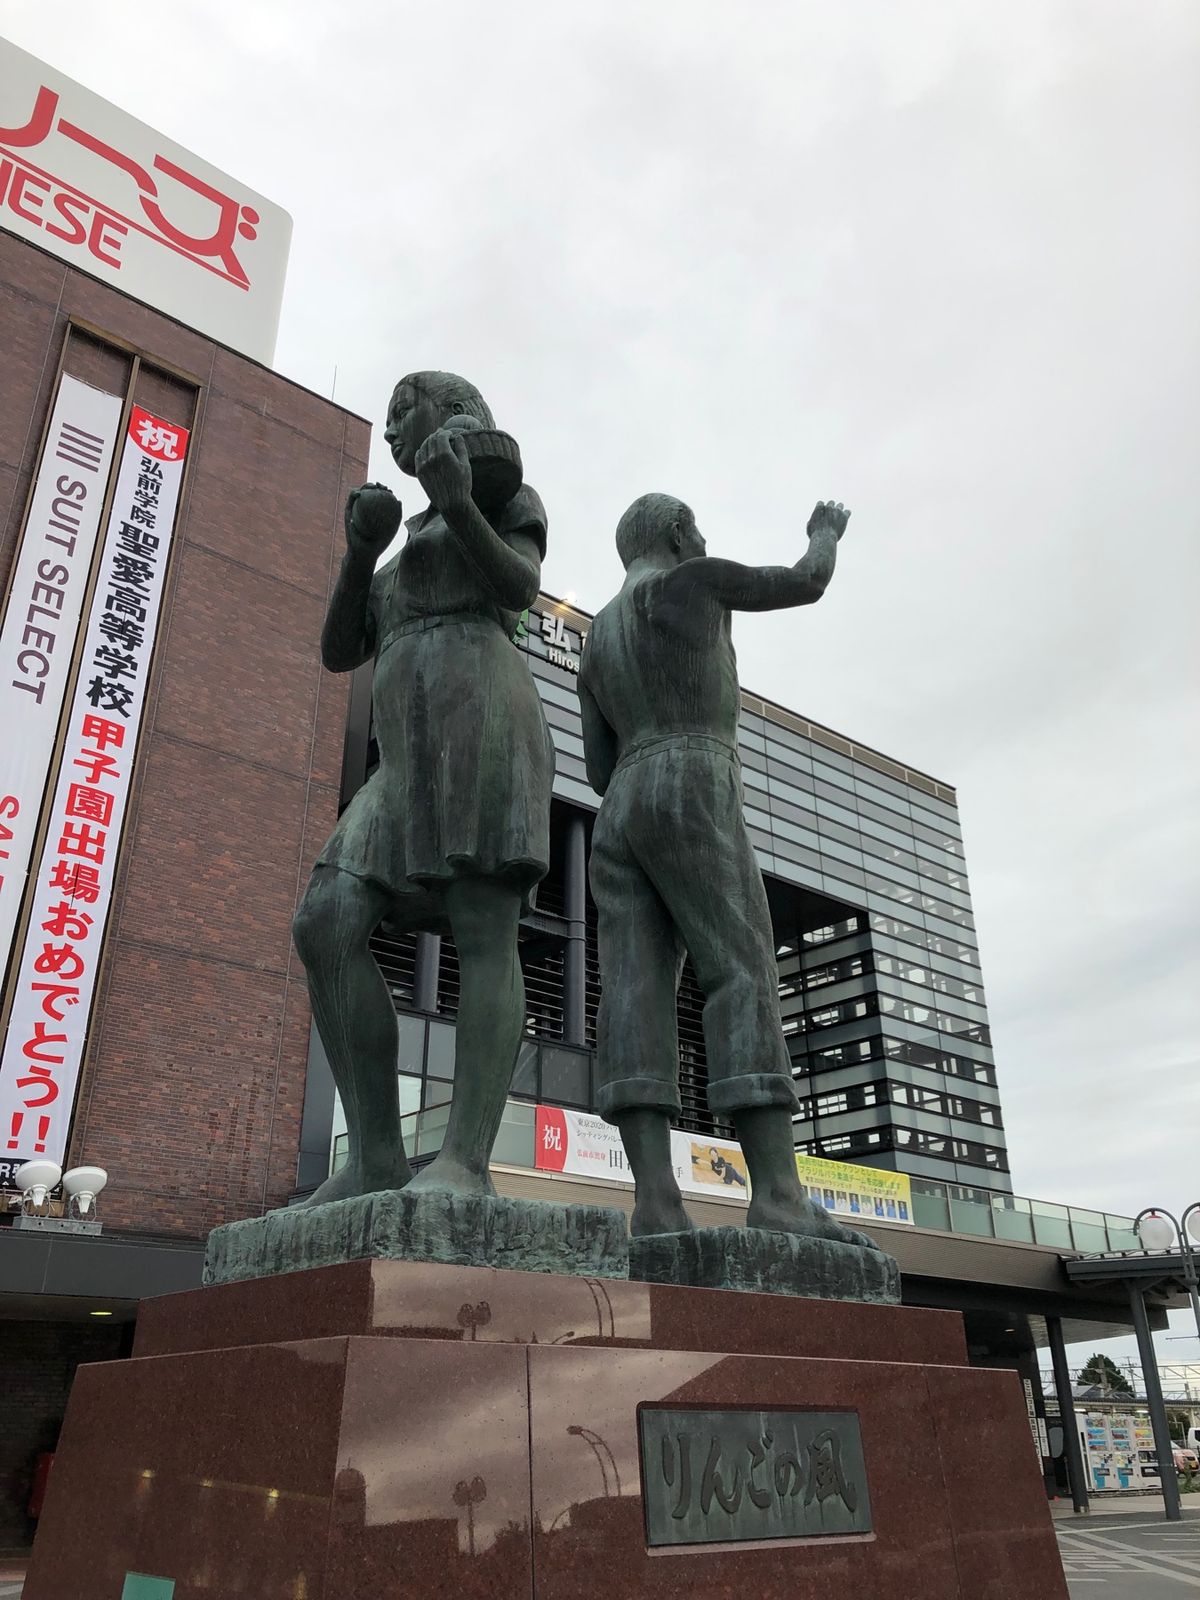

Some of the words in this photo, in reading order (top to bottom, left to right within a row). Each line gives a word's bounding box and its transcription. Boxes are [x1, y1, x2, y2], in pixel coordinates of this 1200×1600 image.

[136, 416, 180, 460] 祝
[45, 474, 88, 557] SUIT
[12, 558, 70, 705] SELECT
[542, 1124, 562, 1151] 祝
